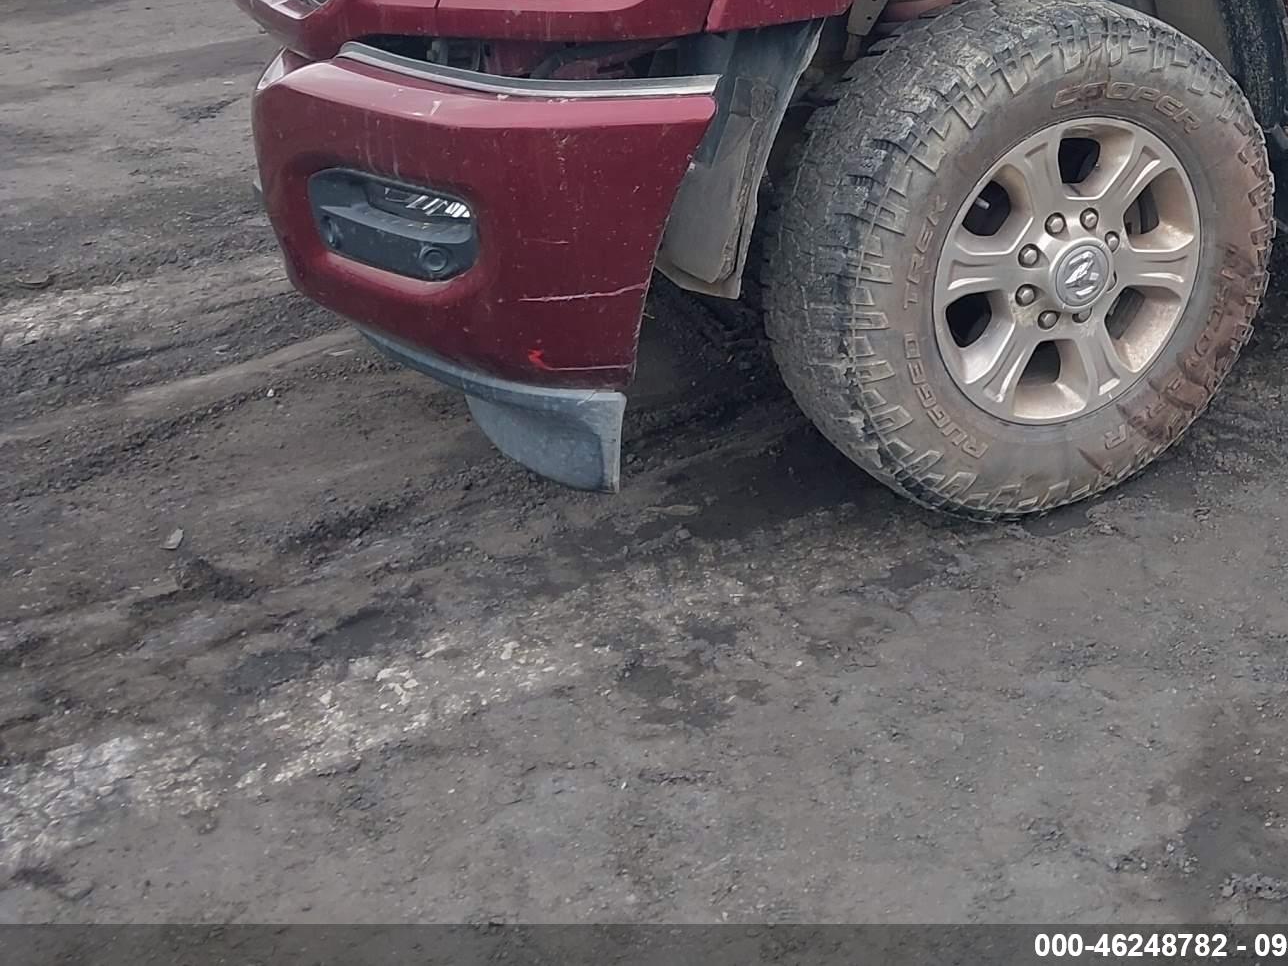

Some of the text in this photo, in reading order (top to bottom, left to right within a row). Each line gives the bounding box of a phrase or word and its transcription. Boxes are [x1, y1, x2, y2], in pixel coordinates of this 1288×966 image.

[1051, 81, 1202, 134] COOPER
[903, 194, 990, 460] RUGGED TREK
